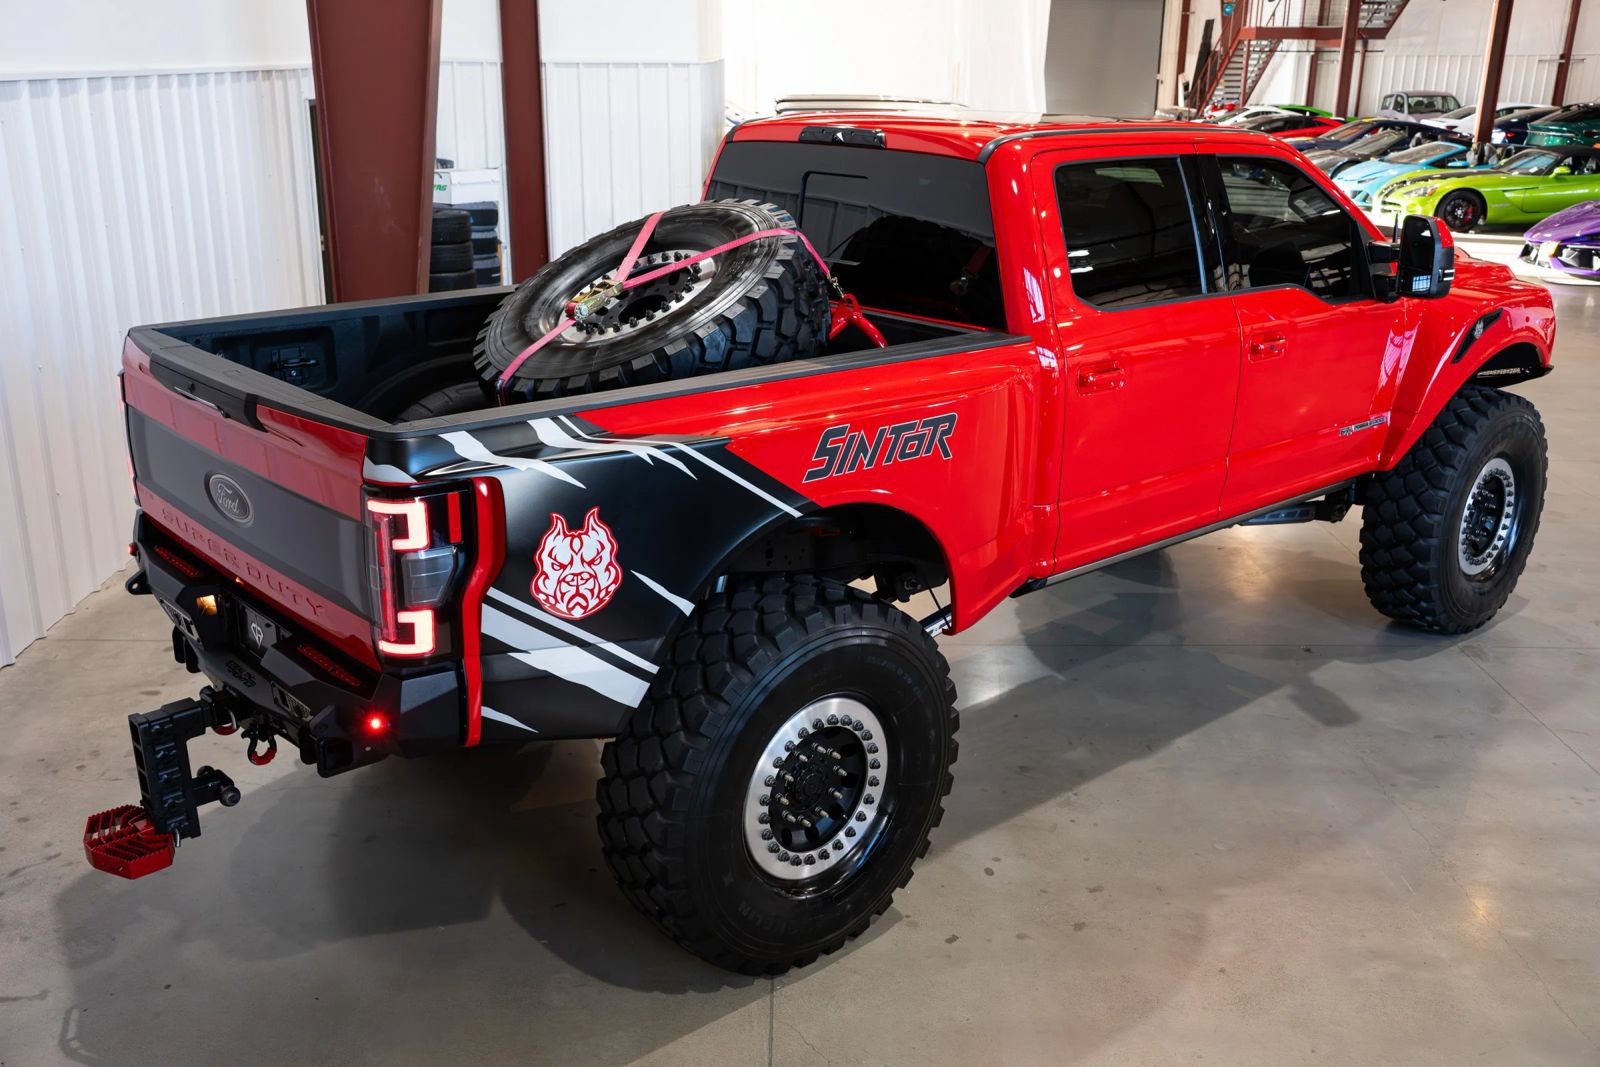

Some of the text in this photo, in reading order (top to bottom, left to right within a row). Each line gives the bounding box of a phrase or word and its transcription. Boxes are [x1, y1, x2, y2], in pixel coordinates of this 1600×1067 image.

[802, 412, 958, 484] SINTOR
[217, 482, 240, 515] Ford
[162, 506, 325, 617] SUPER DUTY
